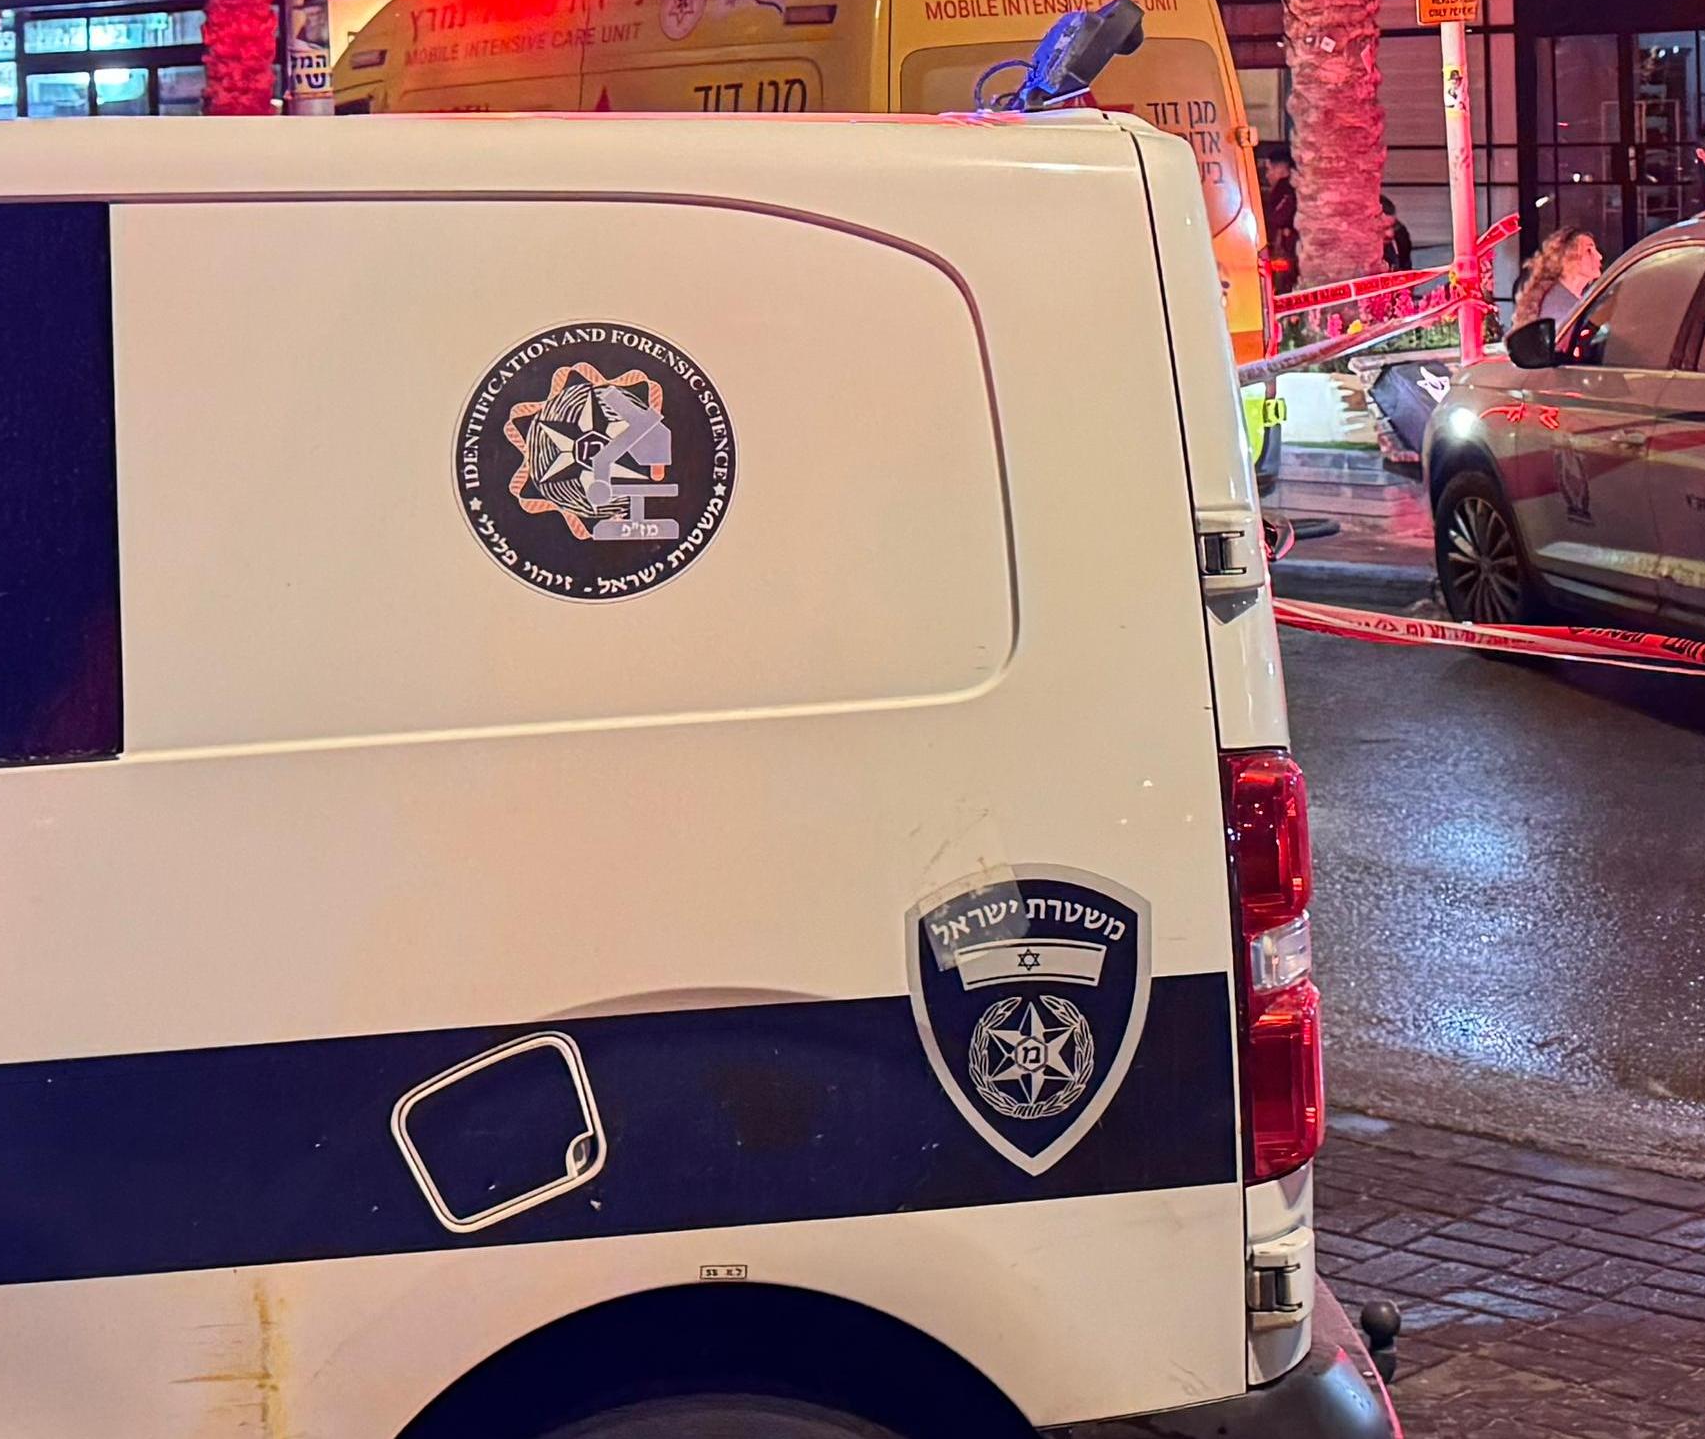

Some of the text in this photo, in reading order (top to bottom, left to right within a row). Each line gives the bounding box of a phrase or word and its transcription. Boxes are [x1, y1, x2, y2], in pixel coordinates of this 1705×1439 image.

[405, 22, 643, 66] MOBILE INTENSIVE CARE UNIT
[1146, 101, 1217, 129] מגן דוד
[464, 328, 729, 490] IDENTIFICATION AND FORENSIC SCIENCE
[479, 513, 520, 564] פלילי
[621, 523, 659, 538] מז"פ
[667, 498, 726, 569] משטרת
[523, 560, 575, 591] זיהוי
[597, 563, 665, 595] ישראל
[930, 897, 1127, 946] משטרת ישראל
